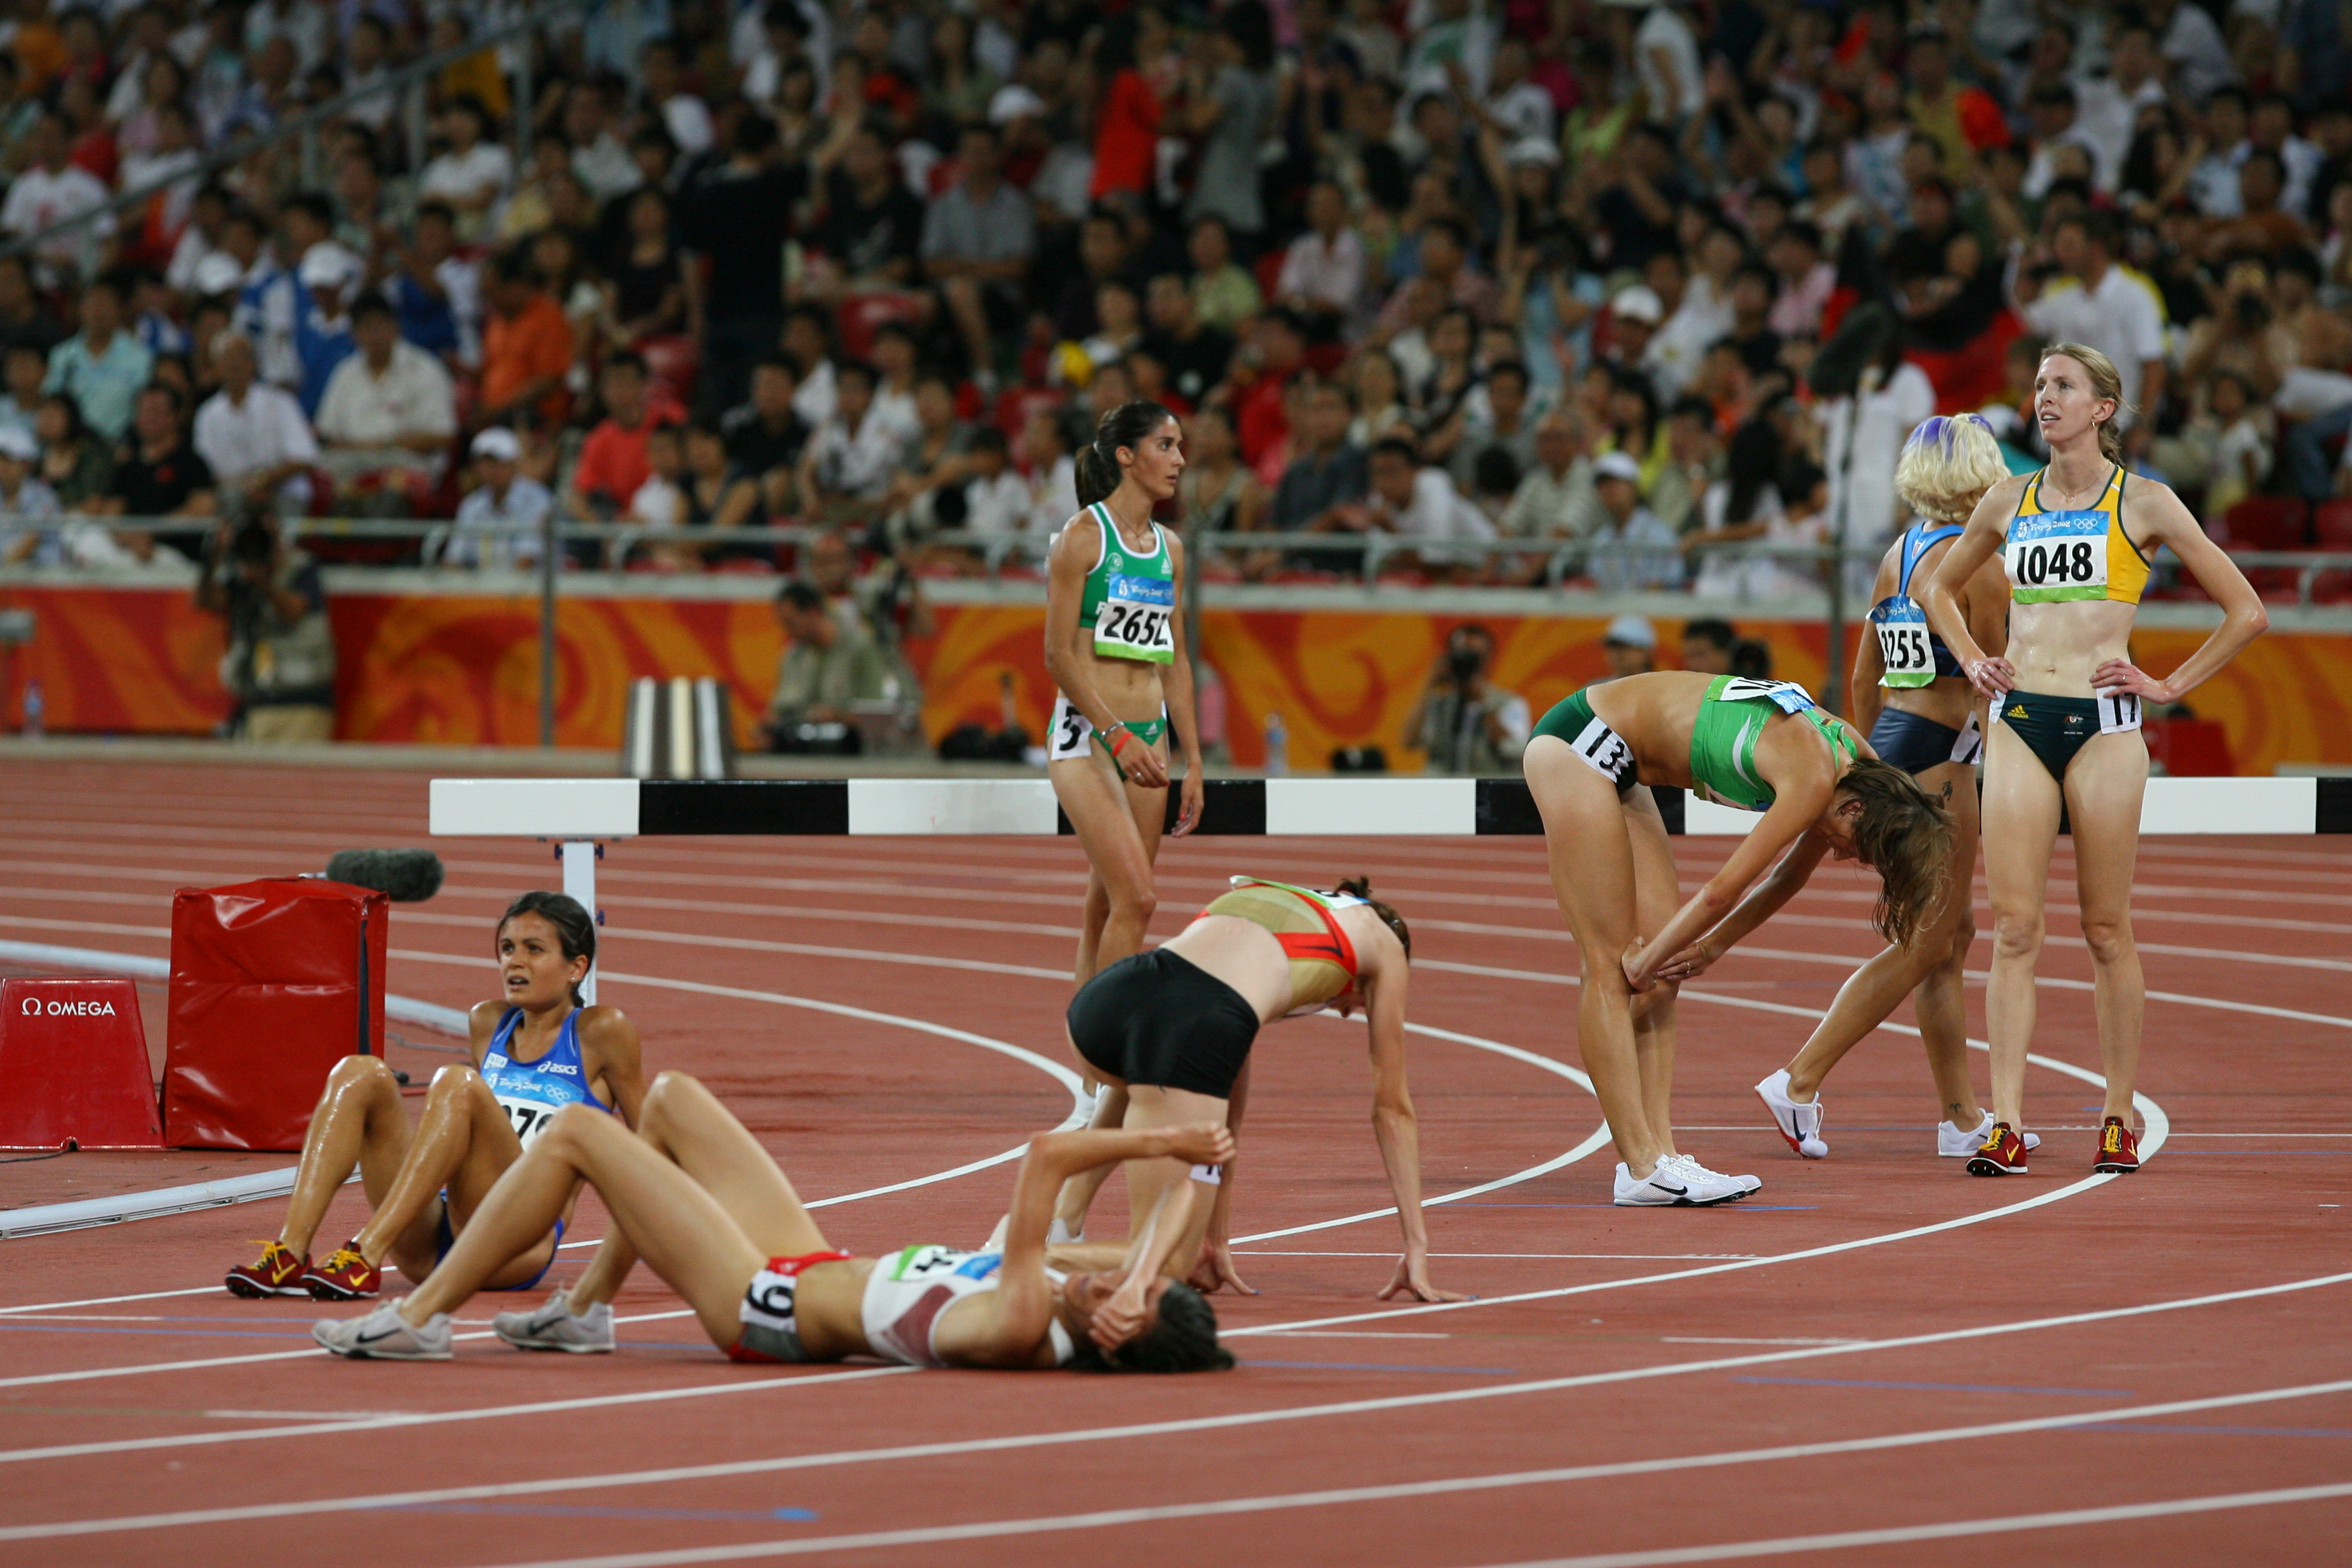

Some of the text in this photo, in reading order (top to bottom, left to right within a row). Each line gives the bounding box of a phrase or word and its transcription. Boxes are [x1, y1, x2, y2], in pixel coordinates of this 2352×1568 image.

[2016, 542, 2093, 585] 1048
[1059, 705, 1082, 751] 5
[1585, 727, 1625, 770] 13
[47, 1001, 115, 1016] OMEGA
[549, 1063, 577, 1075] asics
